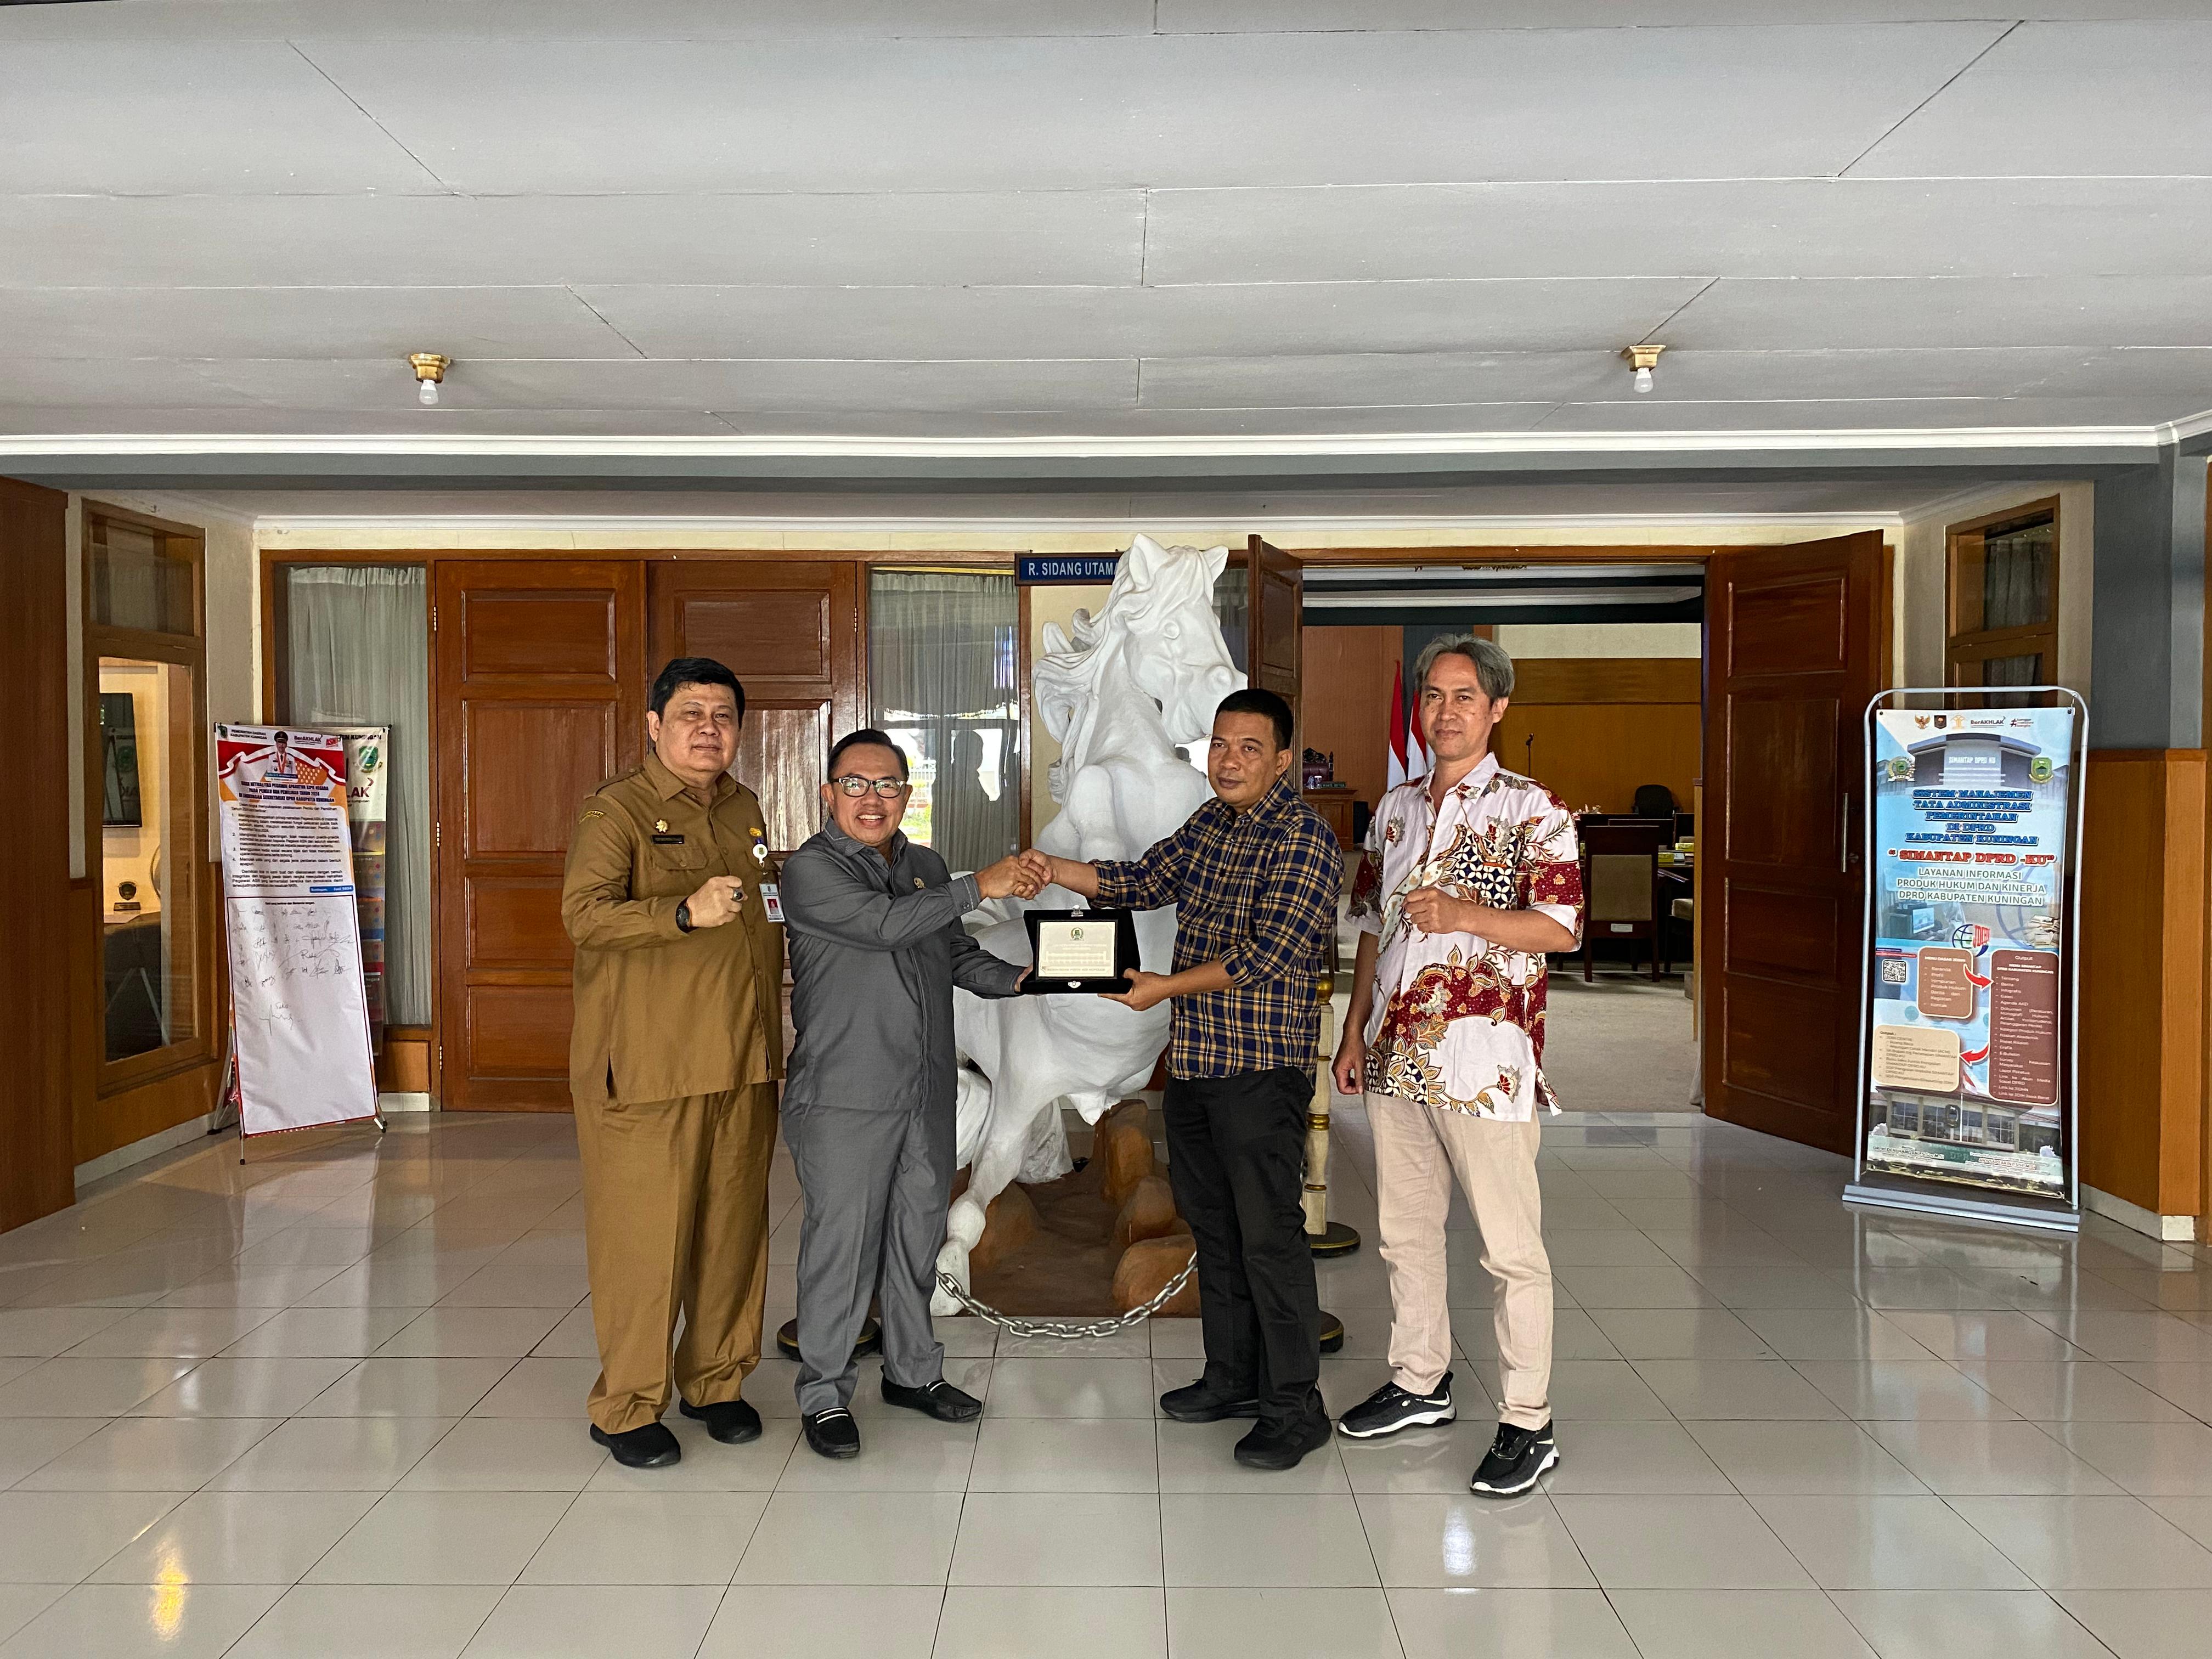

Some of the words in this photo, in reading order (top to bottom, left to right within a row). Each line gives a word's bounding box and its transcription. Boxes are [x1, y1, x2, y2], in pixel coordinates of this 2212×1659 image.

[1029, 562, 1039, 575] R.
[1042, 562, 1081, 575] SIDANG
[1913, 789, 1955, 798] SISTEM
[1959, 791, 2033, 799] MANAJEMEN
[1946, 801, 2032, 810] ADMINISTRASI
[1926, 812, 2018, 821] PEMERINTAHAN
[1947, 823, 1960, 831] DI
[1962, 823, 1995, 832] DPRD
[1906, 833, 1973, 842] KABUPATEN
[1976, 834, 2038, 844] KUNINGAN
[1899, 850, 1972, 862] SIMANTAP
[1975, 852, 2016, 864] DPRD
[1919, 868, 1963, 876] LAYANAN
[1966, 869, 2021, 879] INFORMASI
[1897, 879, 1937, 888] PRODUK
[1939, 881, 1974, 889] HUKUM
[2002, 884, 2045, 893] KINERJA
[1899, 890, 1925, 899] DPRD
[1928, 893, 1984, 902] KABUPATEN
[1988, 895, 2042, 905] KUNINGAN
